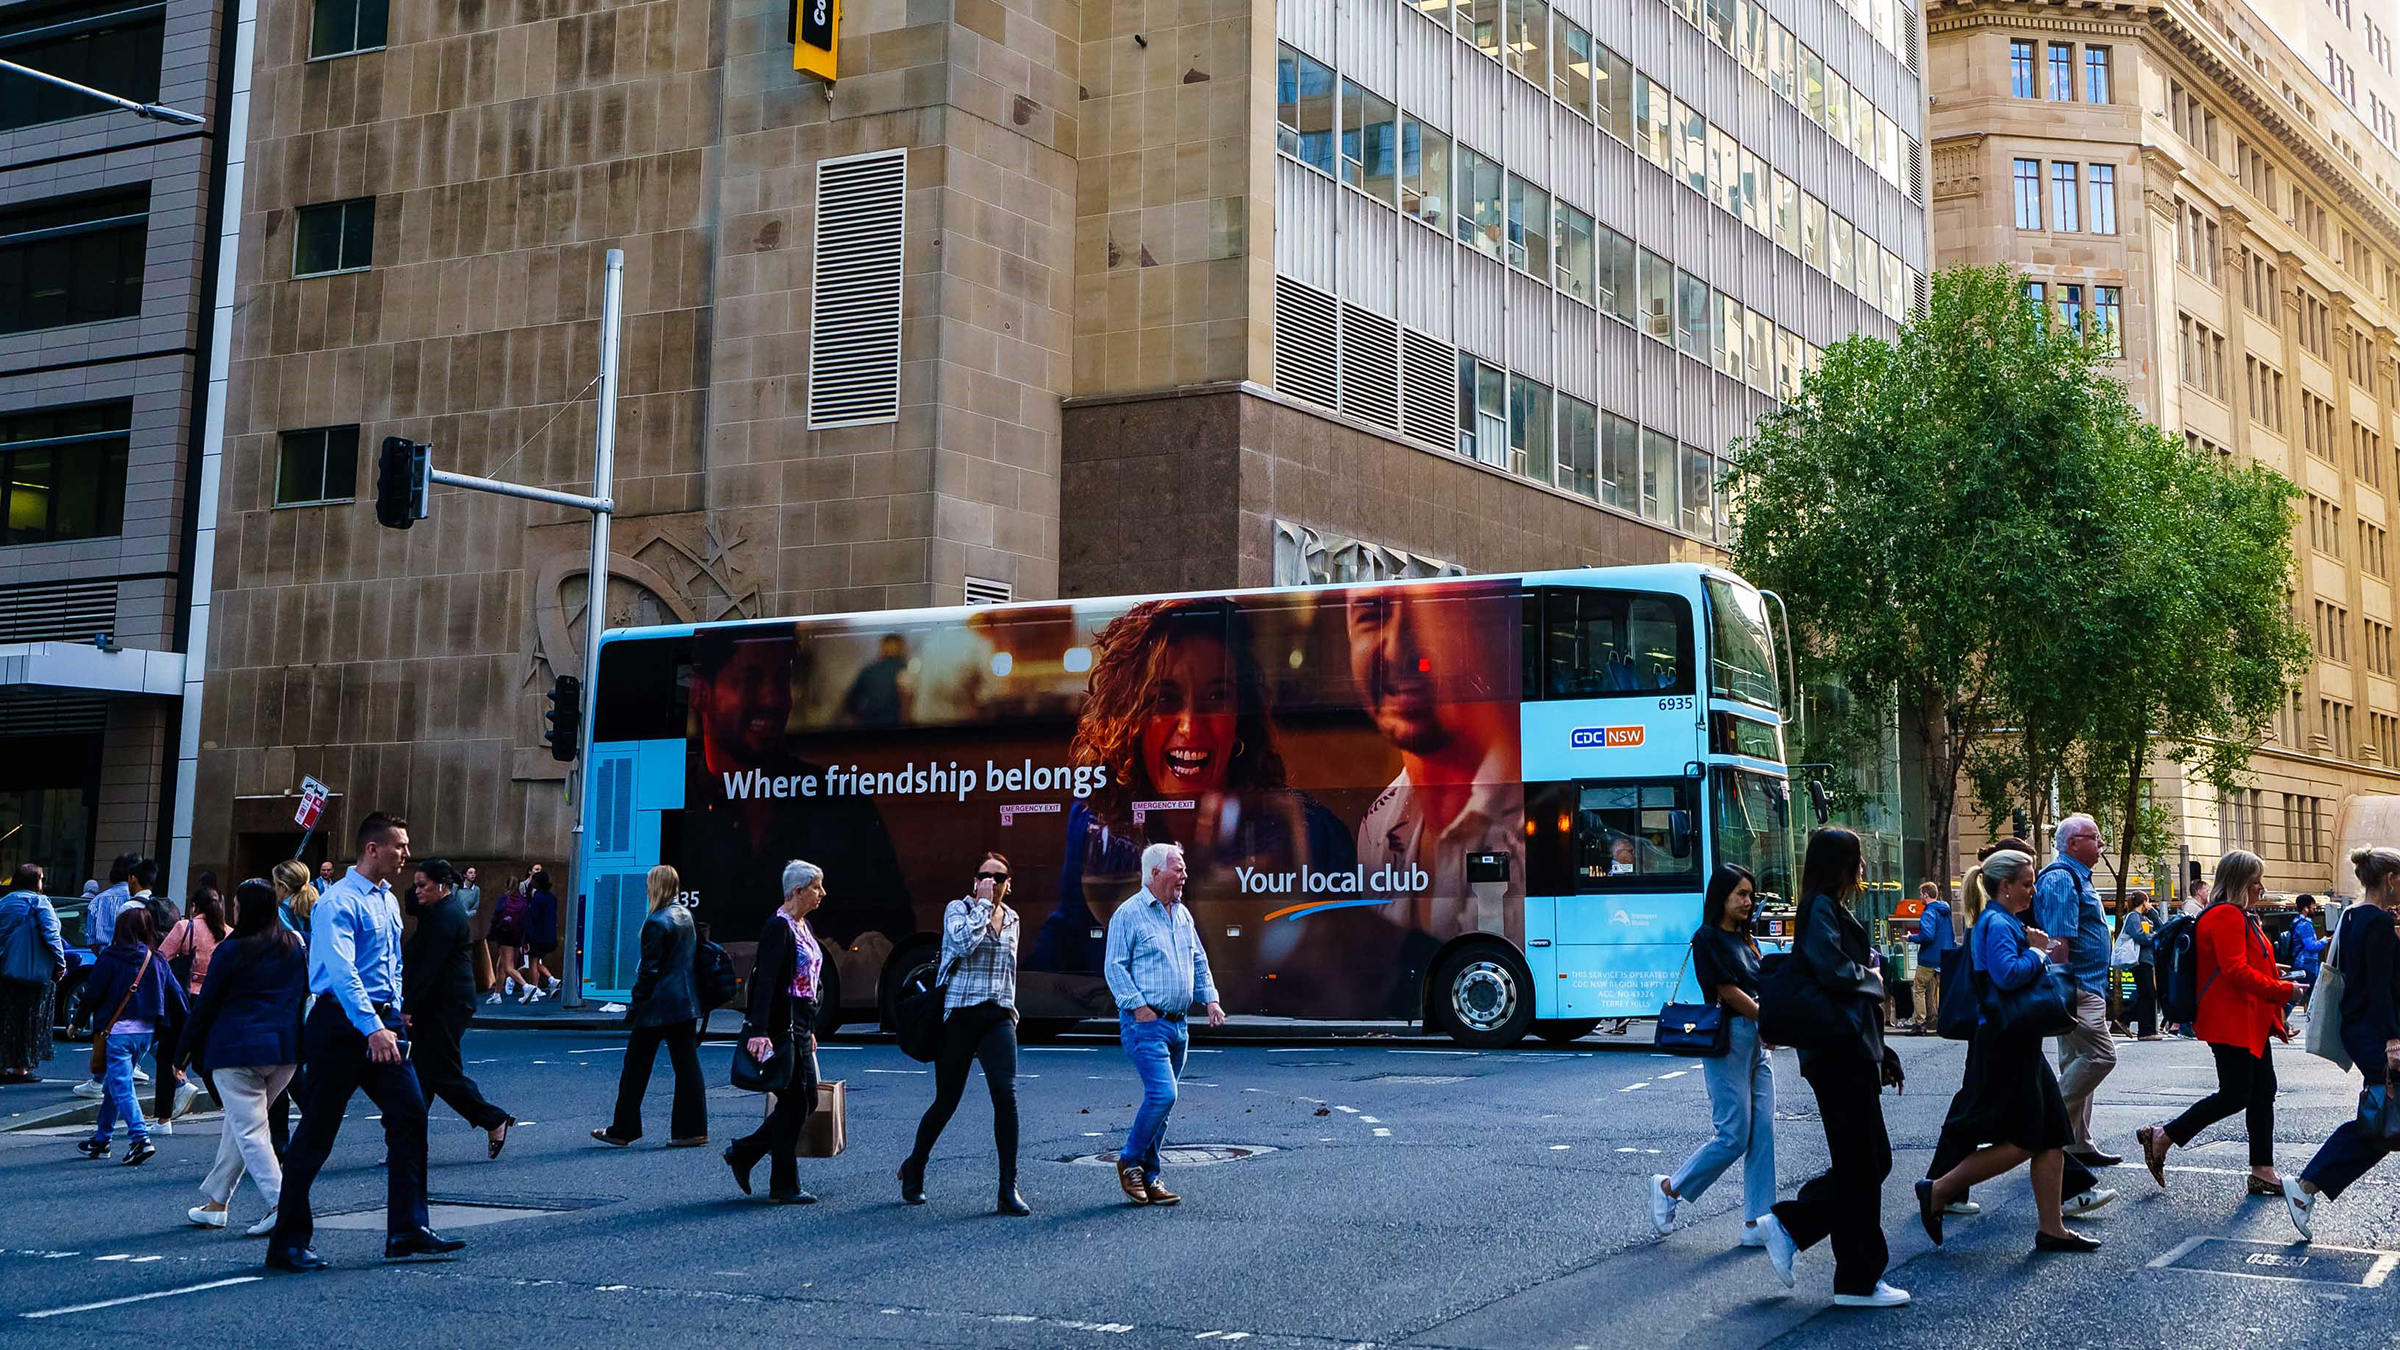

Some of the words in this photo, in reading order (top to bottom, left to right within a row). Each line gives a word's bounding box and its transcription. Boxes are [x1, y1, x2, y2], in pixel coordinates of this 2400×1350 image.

[1658, 697, 1693, 711] 6935
[1574, 731, 1603, 744] CDC
[1608, 730, 1641, 743] NSW
[723, 768, 818, 800] Where
[825, 761, 977, 802] friendship
[986, 758, 1107, 798] belongs
[1001, 804, 1043, 813] EMERGENCY
[1133, 801, 1177, 810] EMERGENCY
[1234, 866, 1297, 894] Your
[1302, 863, 1364, 893] local
[1370, 862, 1429, 893] club
[1571, 971, 1587, 979] THIS
[1589, 971, 1619, 979] SERVICE
[1620, 971, 1628, 979] IS
[1629, 971, 1668, 979] OPERATED
[1572, 980, 1588, 989] CDC
[1590, 980, 1607, 988] NSW
[1609, 980, 1638, 988] REGION
[1650, 980, 1664, 988] PTY
[1601, 1000, 1628, 1008] TERREY
[1631, 1000, 1651, 1008] HILLS
